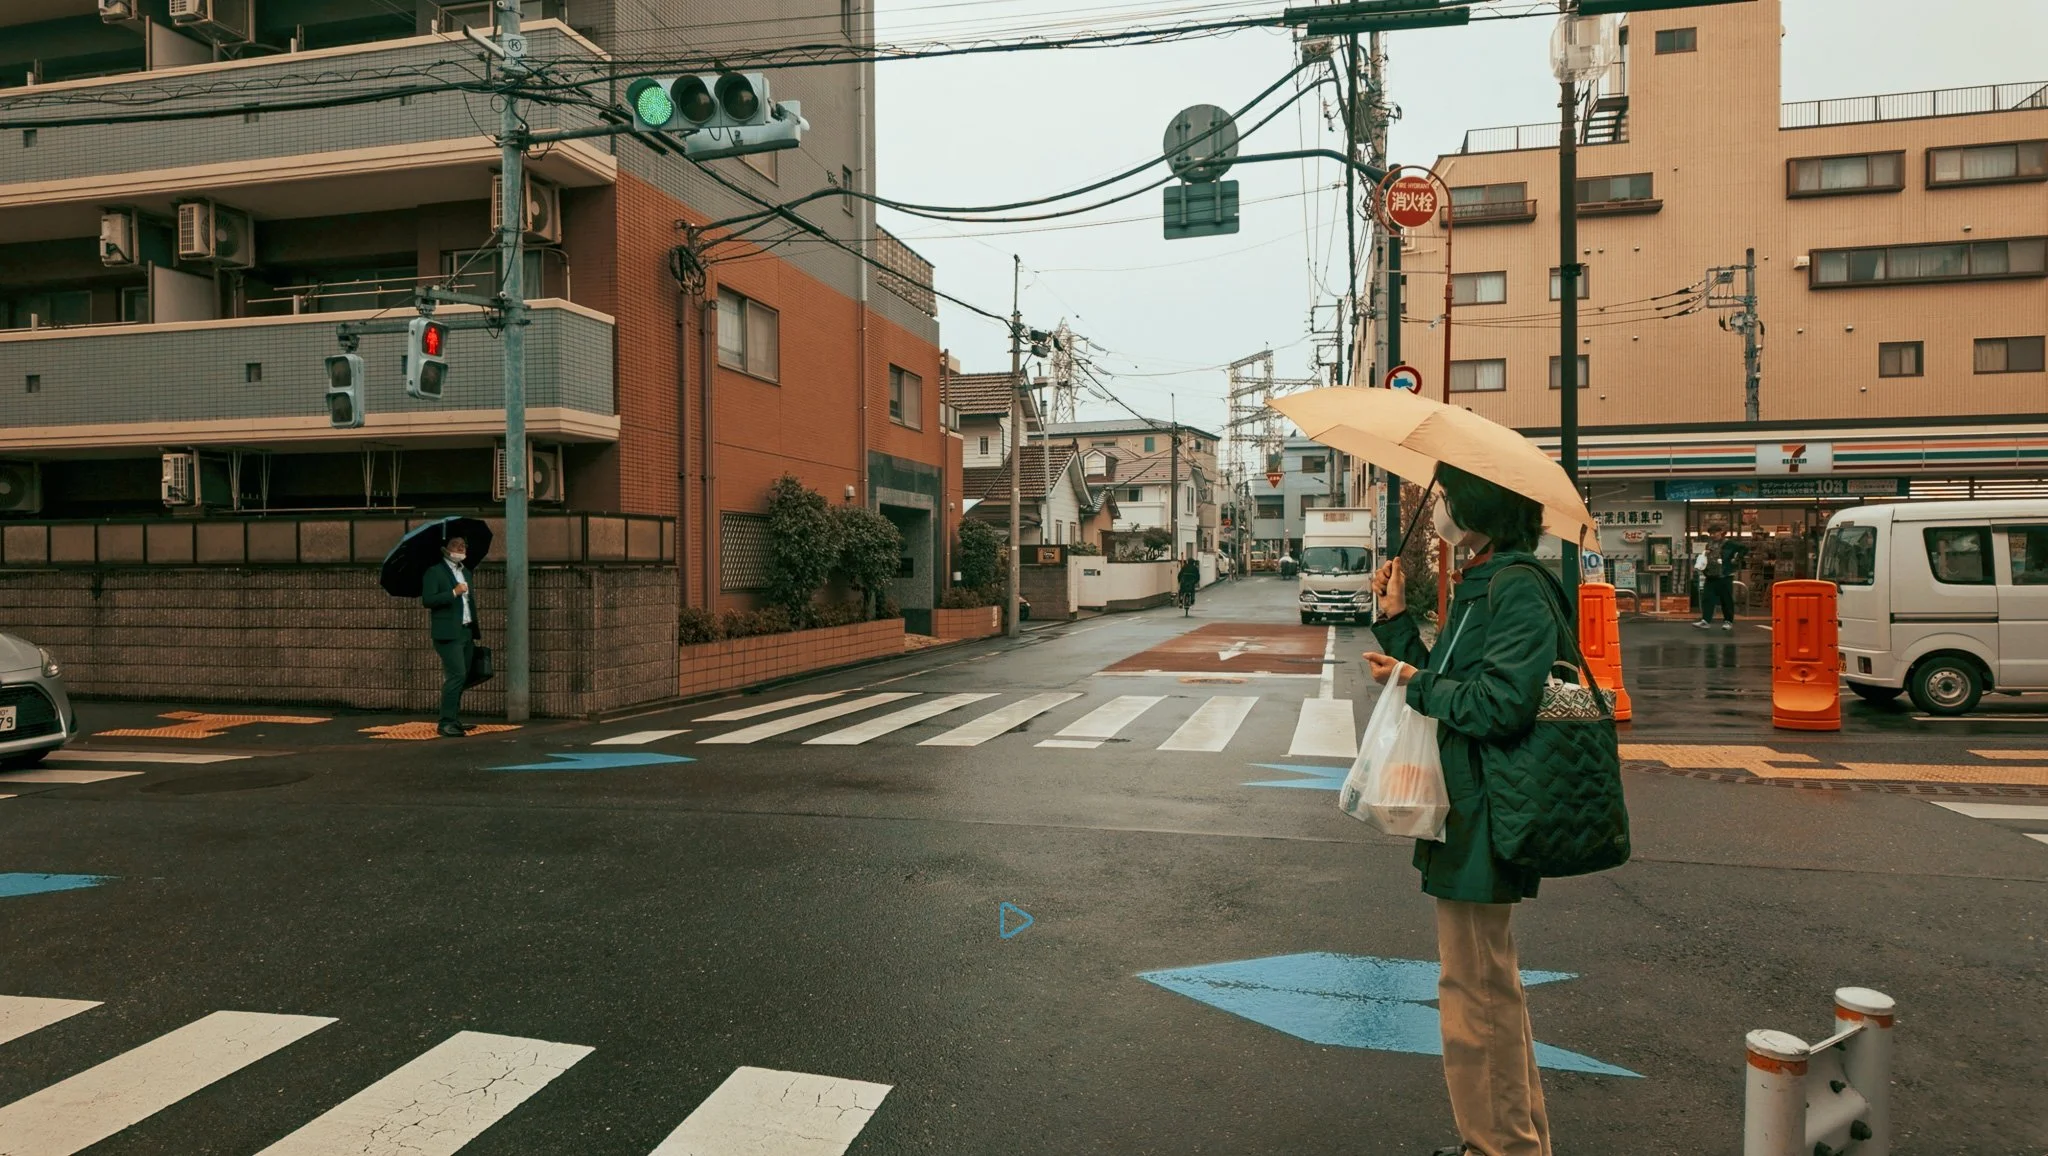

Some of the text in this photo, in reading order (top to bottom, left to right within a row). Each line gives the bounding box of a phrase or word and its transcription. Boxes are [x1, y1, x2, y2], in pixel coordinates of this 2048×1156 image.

[1391, 191, 1434, 212] 消火栓
[1624, 532, 1643, 540] たばこ
